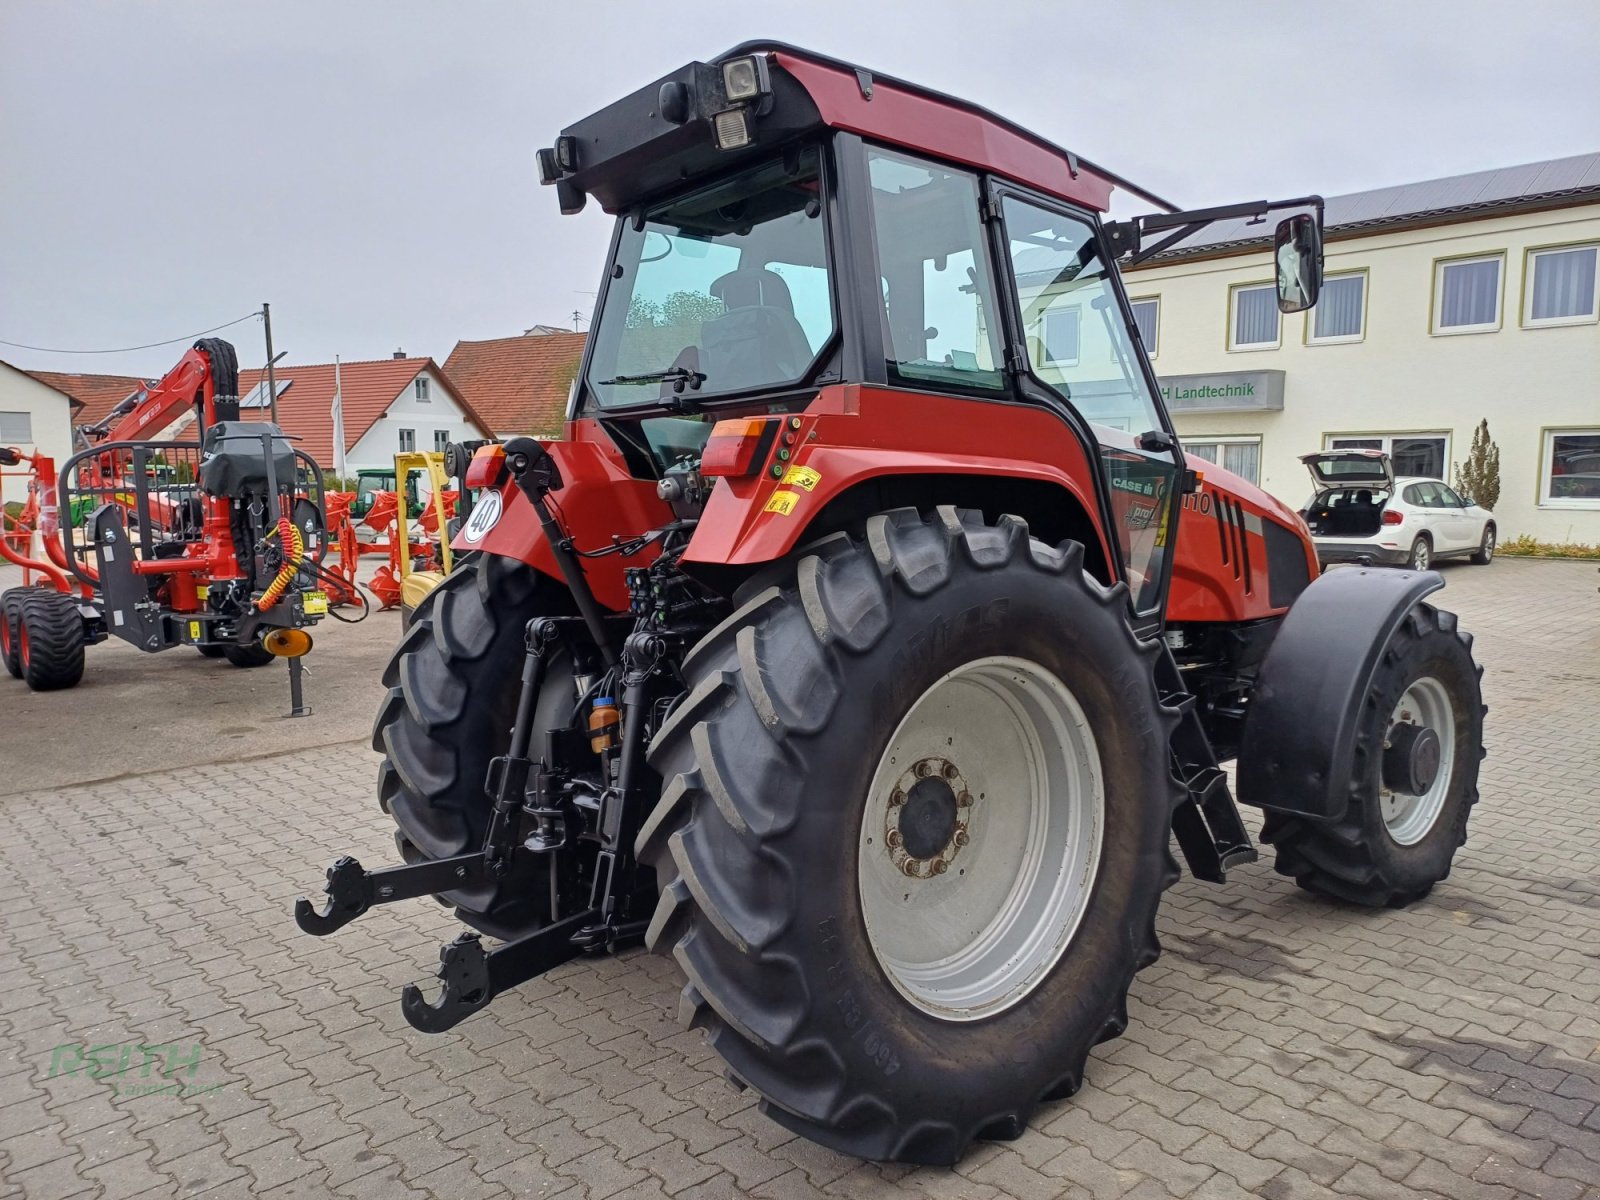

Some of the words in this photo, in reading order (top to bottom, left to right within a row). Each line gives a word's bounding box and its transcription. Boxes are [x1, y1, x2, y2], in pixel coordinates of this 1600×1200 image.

[1175, 382, 1255, 399] Landtechnik
[1112, 478, 1142, 493] CASE
[1182, 493, 1211, 515] 110
[470, 499, 498, 533] 40
